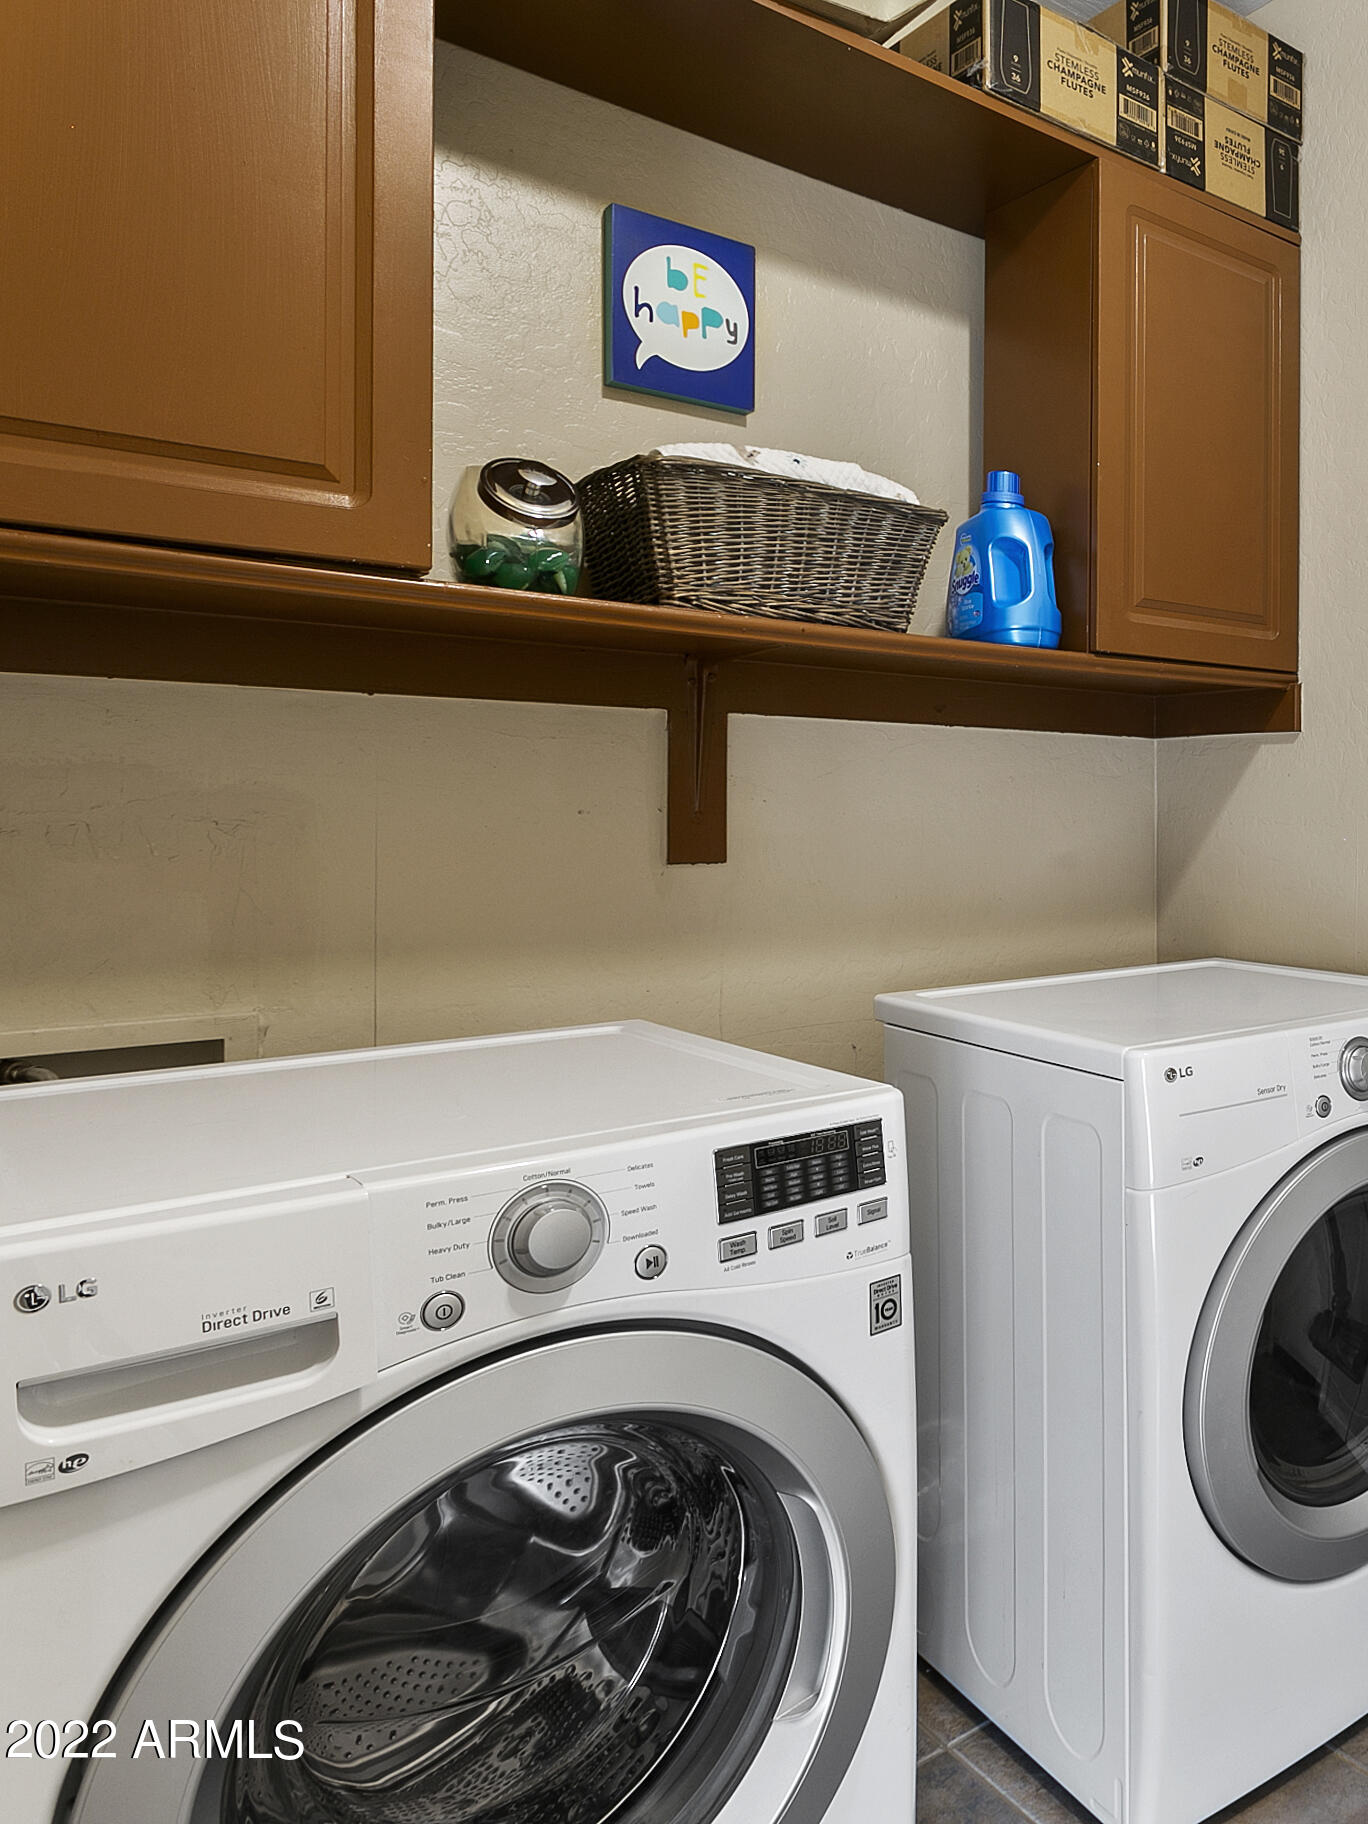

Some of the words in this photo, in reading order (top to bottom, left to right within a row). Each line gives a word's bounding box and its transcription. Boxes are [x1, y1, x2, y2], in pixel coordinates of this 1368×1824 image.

[1219, 38, 1254, 63] STEMLESS
[1054, 52, 1100, 81] STEMLESS
[1212, 44, 1260, 76] CHAMPAGNE
[1223, 59, 1250, 79] FLUTES
[1047, 60, 1107, 95] CHAMPAGNE
[1060, 76, 1094, 99] FLUTES
[1224, 136, 1251, 155] FLUTES
[1214, 140, 1261, 168] CHAMPAGNE
[1220, 151, 1255, 175] STEMLESS
[634, 285, 737, 345] happy
[952, 570, 979, 594] Snuggle
[1179, 1066, 1194, 1078] LG
[1257, 1086, 1276, 1096] Sensor
[1276, 1084, 1286, 1092] Dry
[522, 1167, 571, 1182] Cotton/Normal
[627, 1162, 654, 1172] Delicates
[634, 1181, 655, 1190] Towels
[426, 1199, 445, 1208] Perm.
[448, 1196, 468, 1206] Press
[620, 1207, 640, 1217] Speed
[640, 1203, 658, 1212] Wash
[426, 1216, 471, 1231] Bulky/Large
[780, 1234, 797, 1244] Speed
[782, 1228, 794, 1236] Spin
[428, 1246, 451, 1256] Heavy
[453, 1242, 471, 1252] Duty
[729, 1240, 746, 1249] Wash
[729, 1247, 746, 1256] Temp
[430, 1275, 444, 1284] Tub
[446, 1272, 466, 1282] Clean
[58, 1277, 98, 1304] LG
[201, 1305, 247, 1321] Inverter
[202, 1314, 248, 1333] Direct
[252, 1305, 291, 1322] Drive
[874, 1298, 898, 1324] 10
